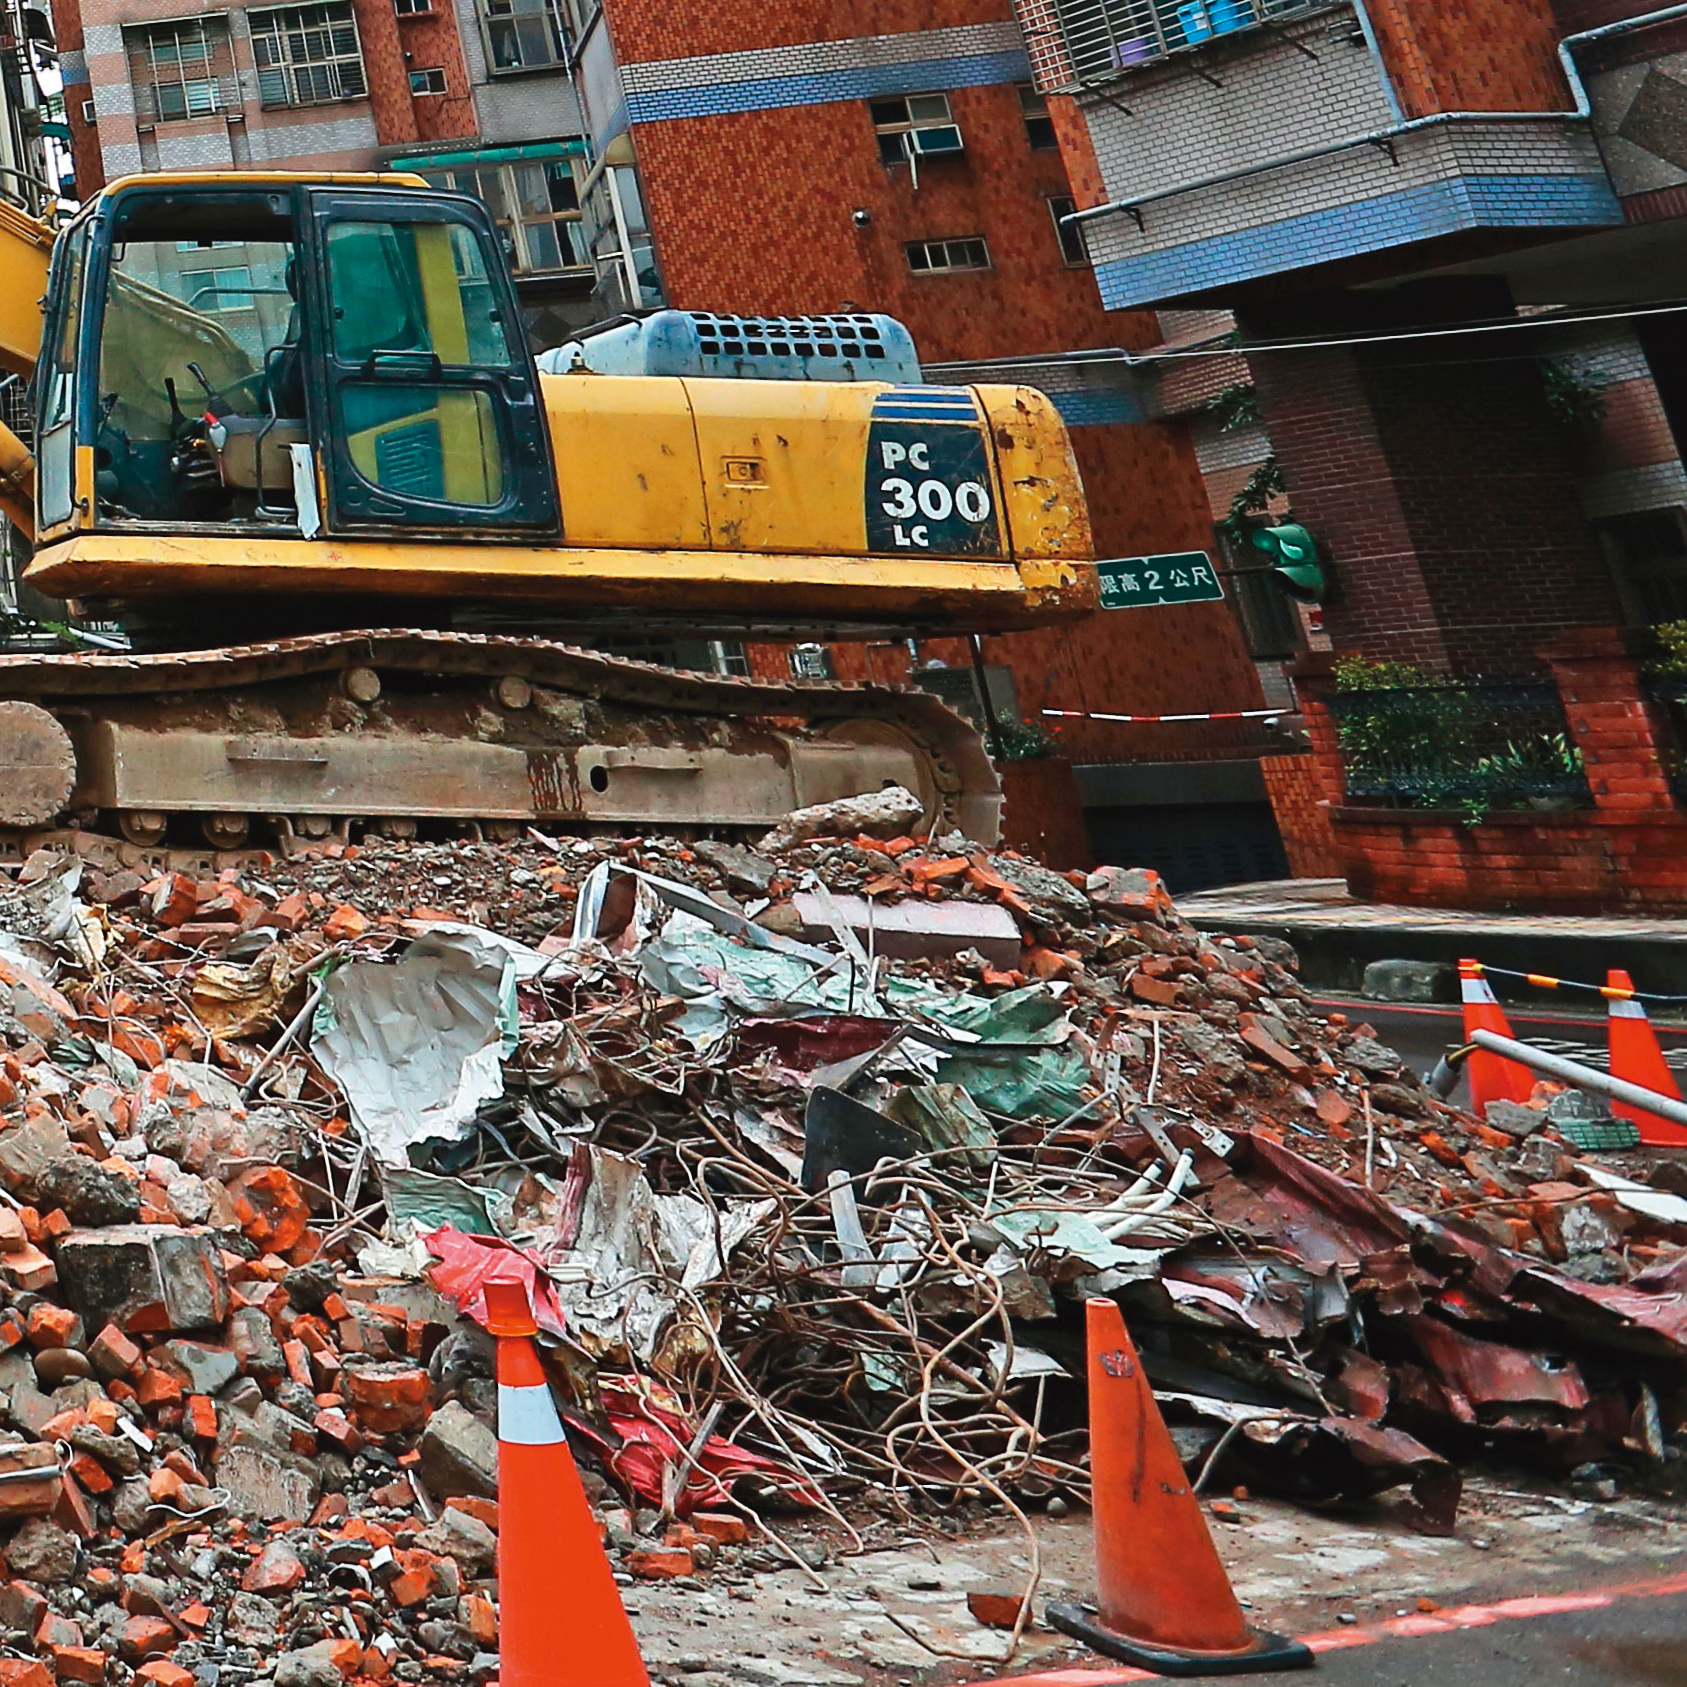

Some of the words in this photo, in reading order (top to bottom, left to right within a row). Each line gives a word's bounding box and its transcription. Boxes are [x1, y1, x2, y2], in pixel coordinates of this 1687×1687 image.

[880, 441, 930, 471] PC
[880, 477, 991, 523] 300
[893, 524, 929, 547] LC
